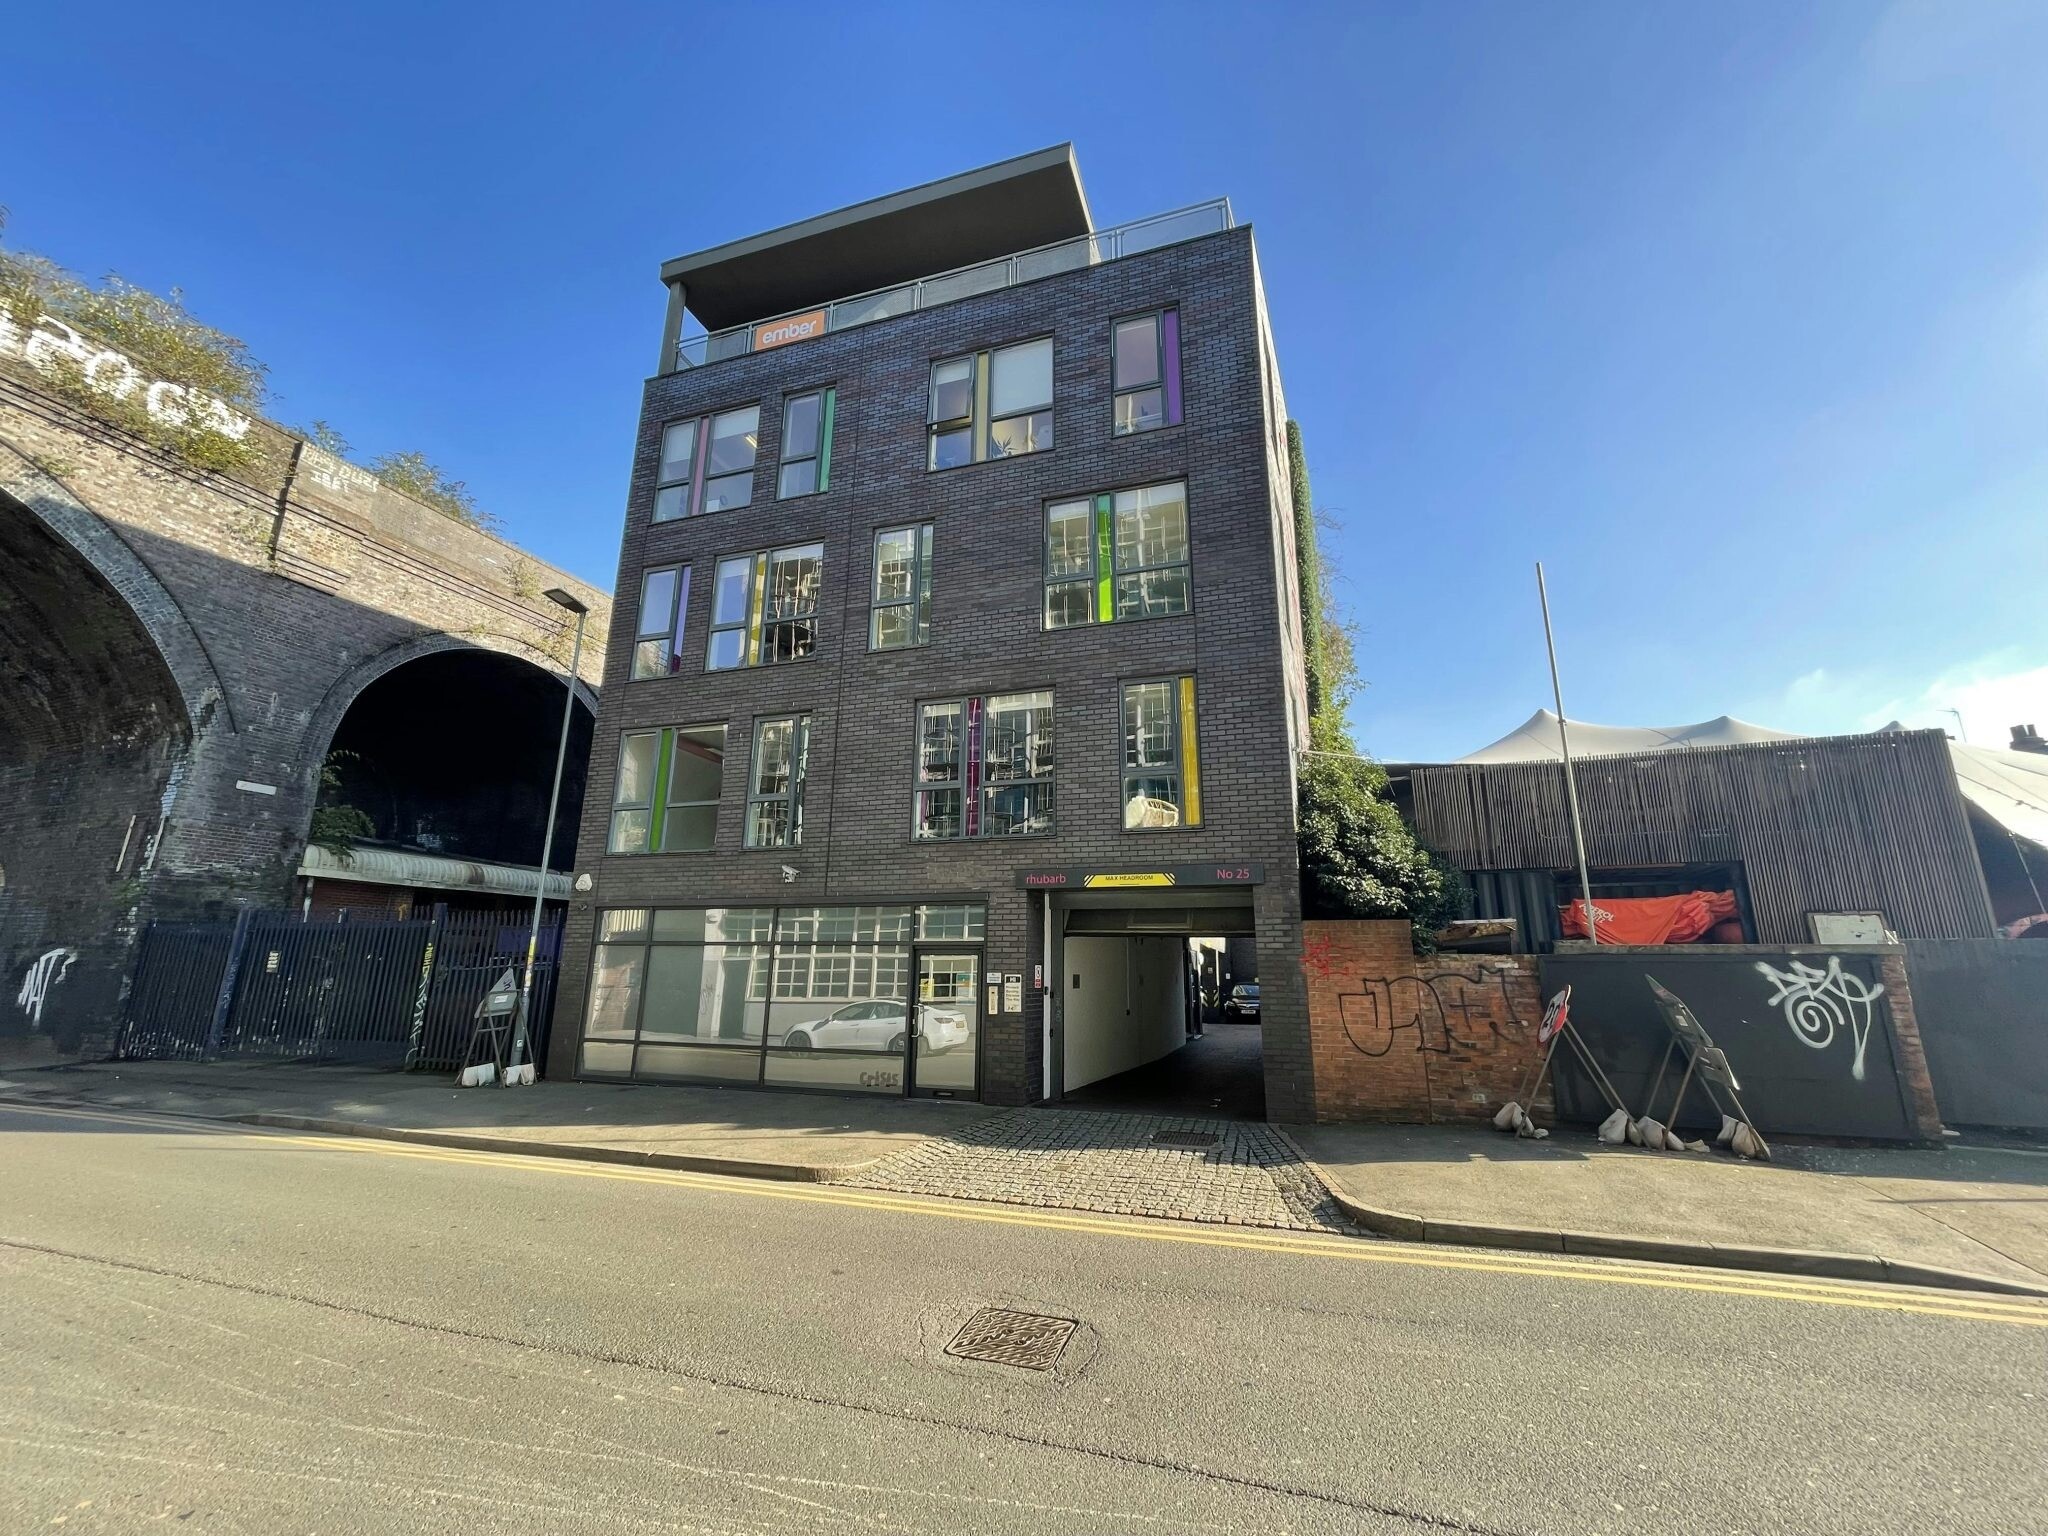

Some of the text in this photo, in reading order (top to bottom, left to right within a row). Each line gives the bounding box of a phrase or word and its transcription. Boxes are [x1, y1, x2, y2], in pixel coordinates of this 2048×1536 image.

[763, 320, 816, 343] ember
[1026, 873, 1066, 884] rhubarb
[1217, 868, 1250, 879] No 25
